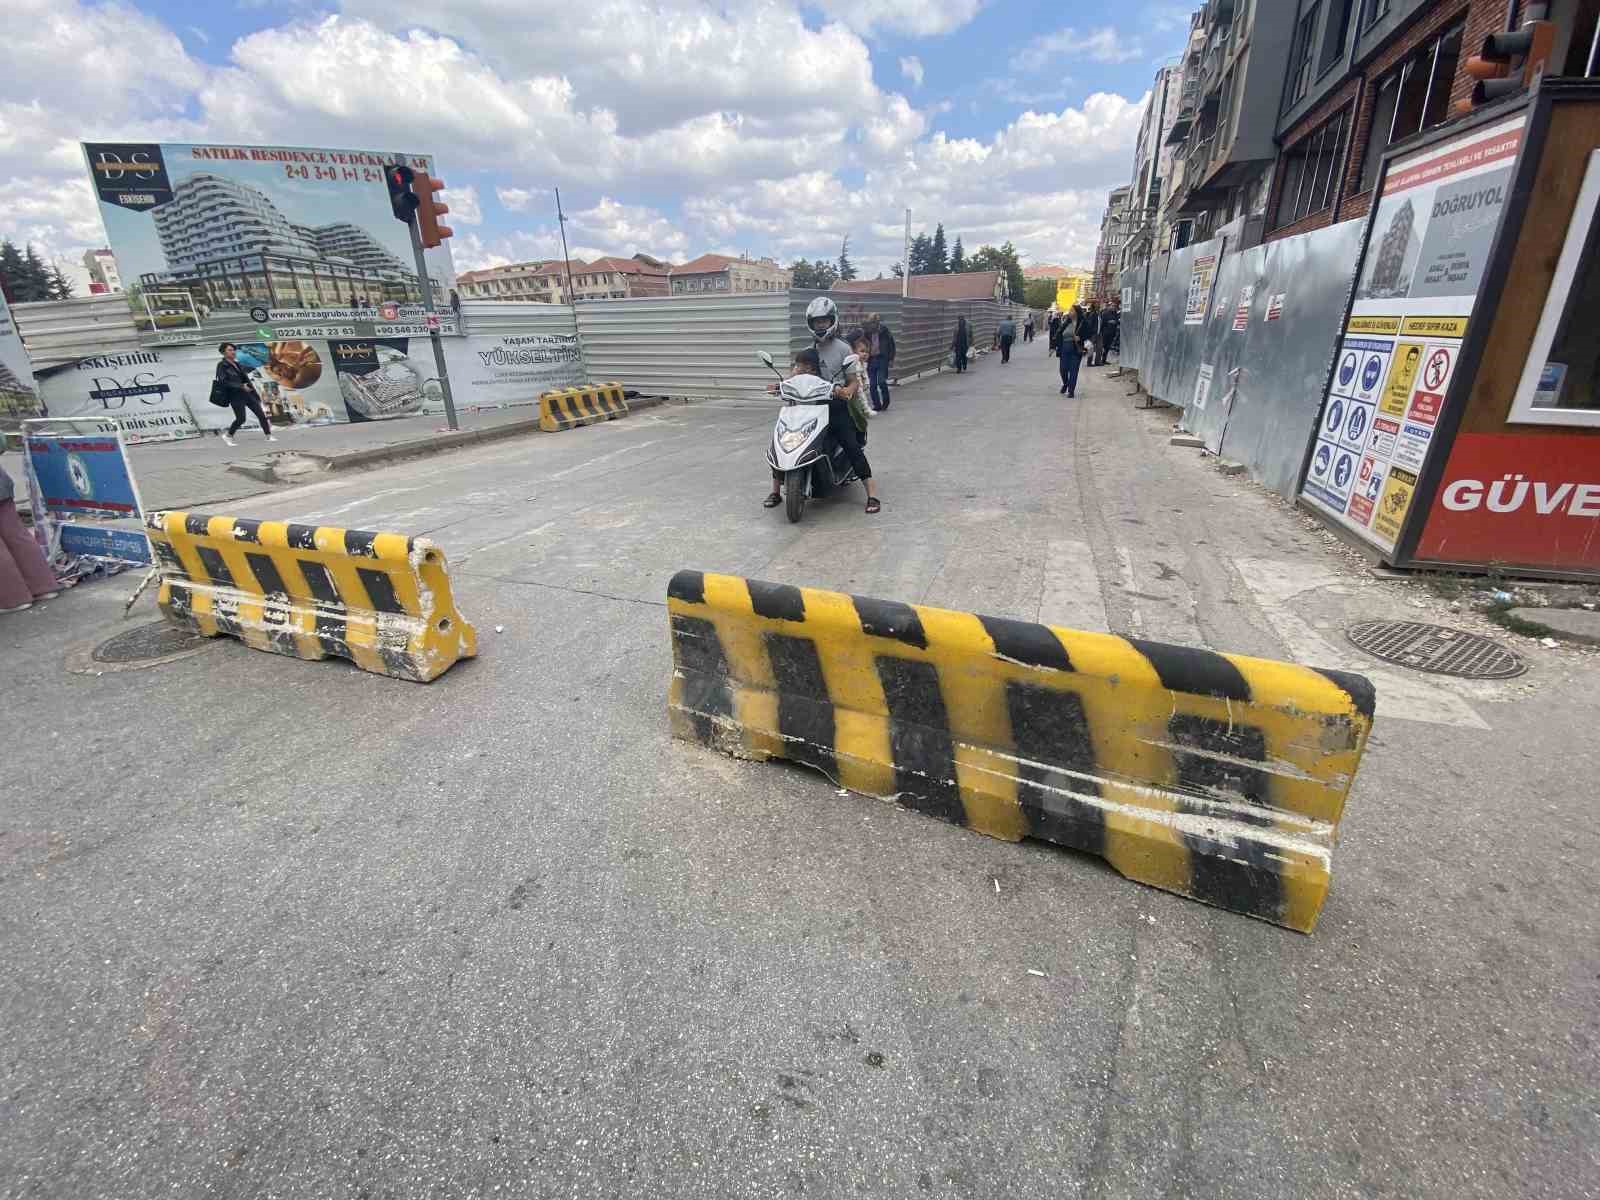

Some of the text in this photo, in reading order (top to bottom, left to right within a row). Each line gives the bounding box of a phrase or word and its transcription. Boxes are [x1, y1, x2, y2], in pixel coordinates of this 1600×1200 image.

[191, 147, 249, 160] SATILIK
[285, 164, 308, 178] 2+0
[313, 165, 337, 180] 3+0
[1431, 185, 1503, 218] DOĞRUYOL
[270, 309, 377, 320] www.mirzagrubu.com.tr
[278, 328, 302, 337] 0224
[305, 328, 323, 337] 242
[503, 336, 535, 347] YAŞAM
[1442, 474, 1600, 516] GÜVE
